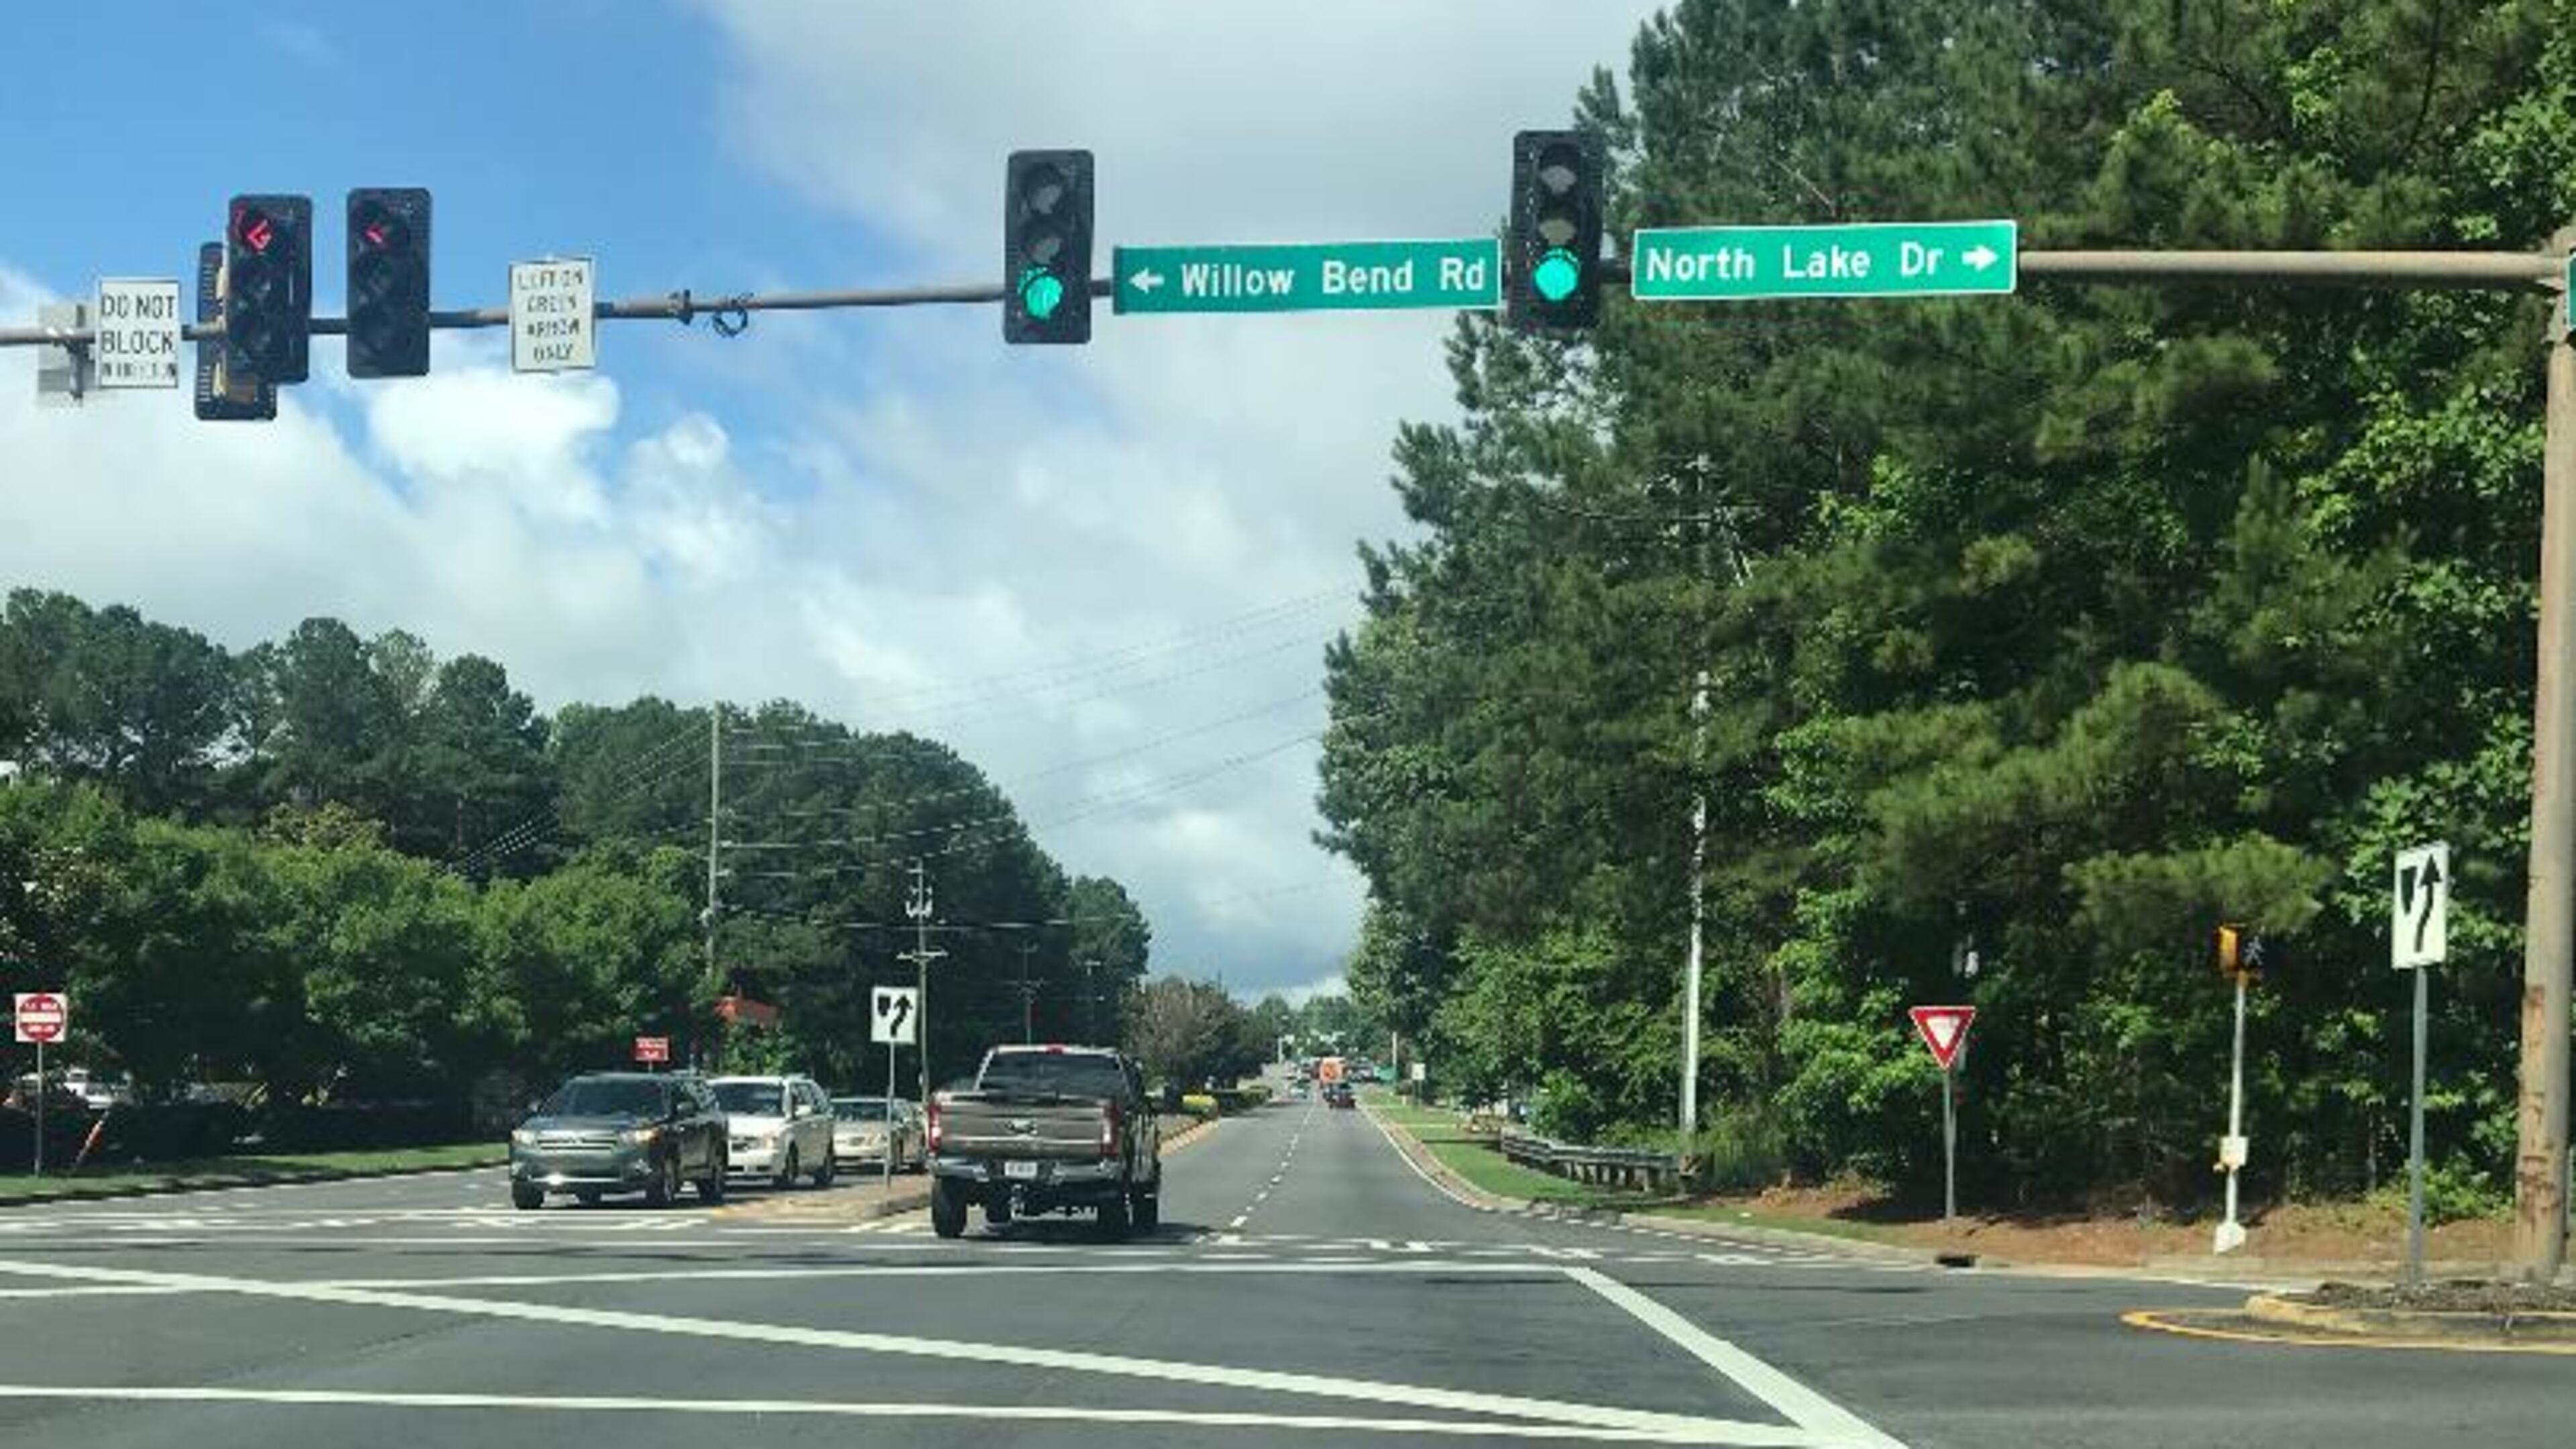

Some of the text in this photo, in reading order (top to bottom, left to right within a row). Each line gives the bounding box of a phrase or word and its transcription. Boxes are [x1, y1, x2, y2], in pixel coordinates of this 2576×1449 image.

[1647, 241, 1943, 281] North Lake Dr
[1181, 258, 1485, 297] Willow Bend Rd
[101, 294, 175, 319] DO NOT
[101, 330, 174, 354] BLOCK
